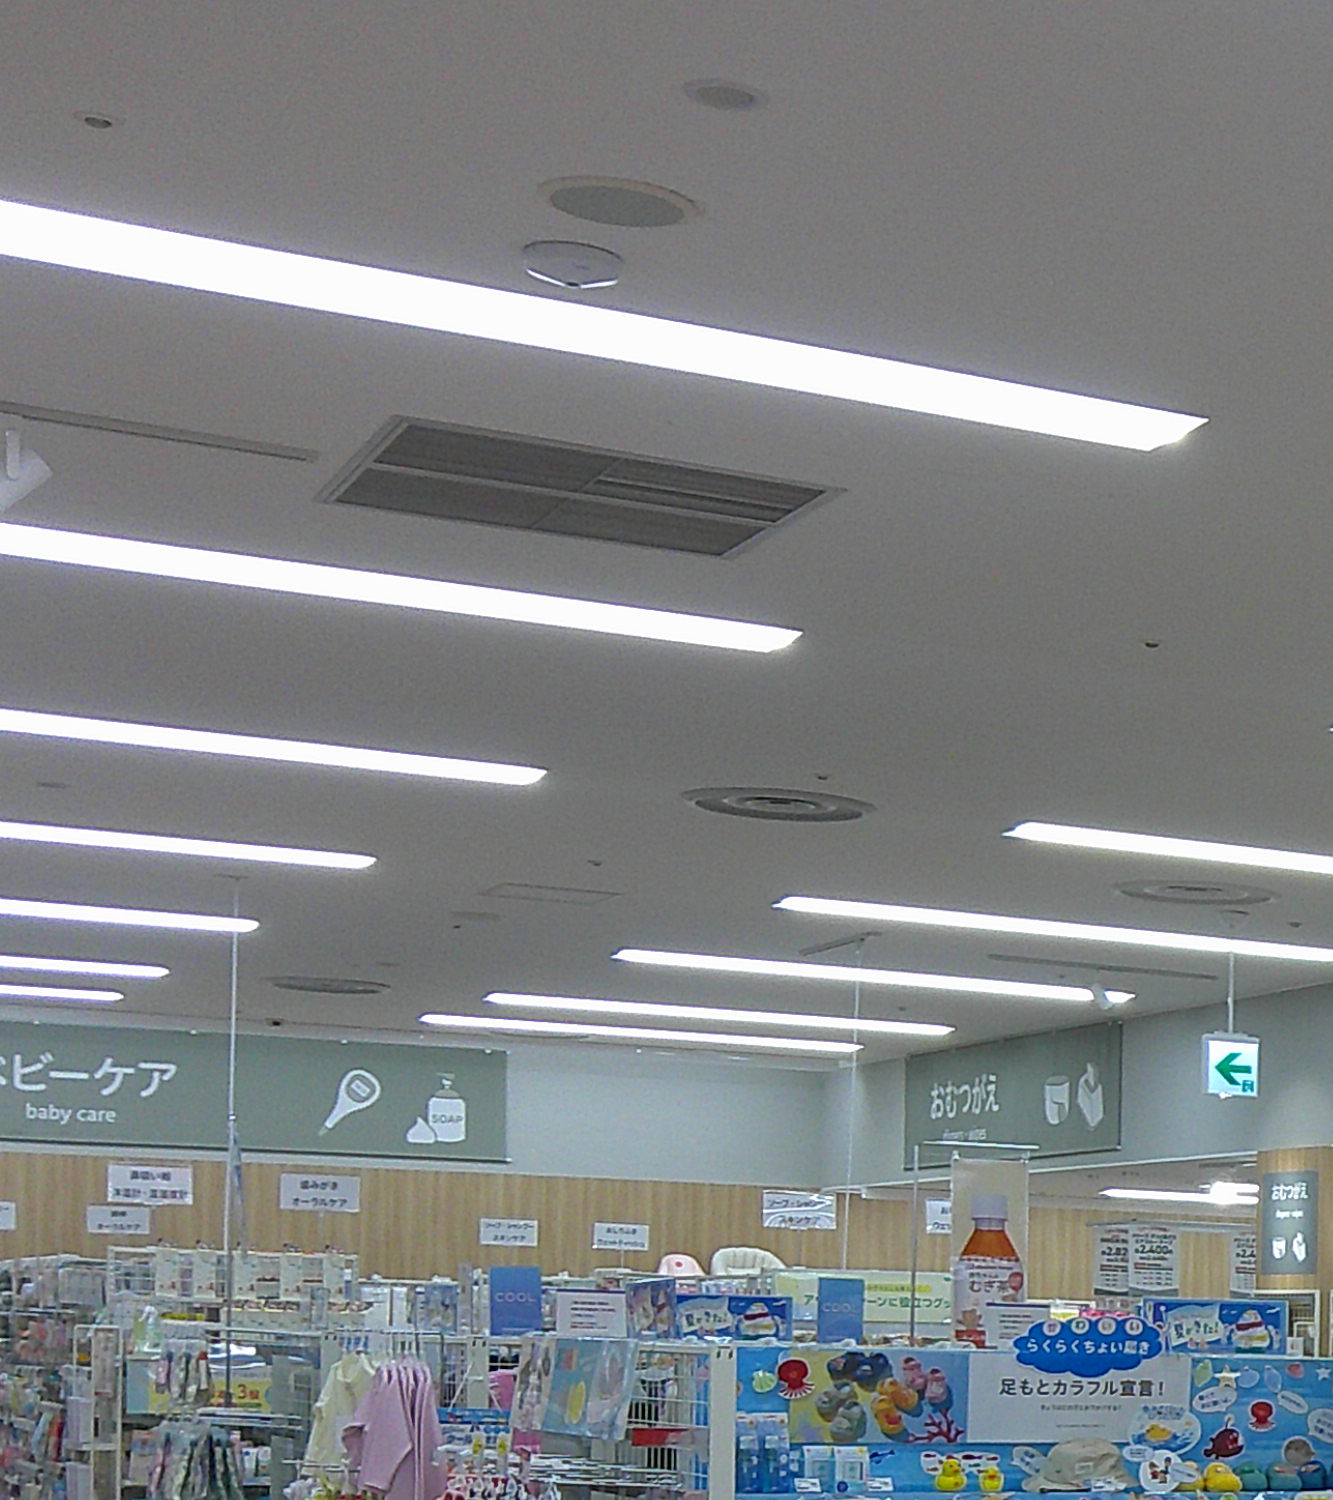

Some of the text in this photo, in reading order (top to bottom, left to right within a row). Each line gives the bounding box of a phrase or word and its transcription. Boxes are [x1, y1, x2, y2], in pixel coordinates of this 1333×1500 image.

[0, 1052, 177, 1097] ビーケア
[930, 1074, 999, 1120] おむつがえ
[26, 1103, 116, 1124] baby care
[431, 1113, 463, 1125] SOAP
[291, 1197, 348, 1209] オーラルケア
[1026, 1338, 1150, 1356] らくらくちょい履き
[999, 1378, 1166, 1397] 足もとカラフル宣言！
